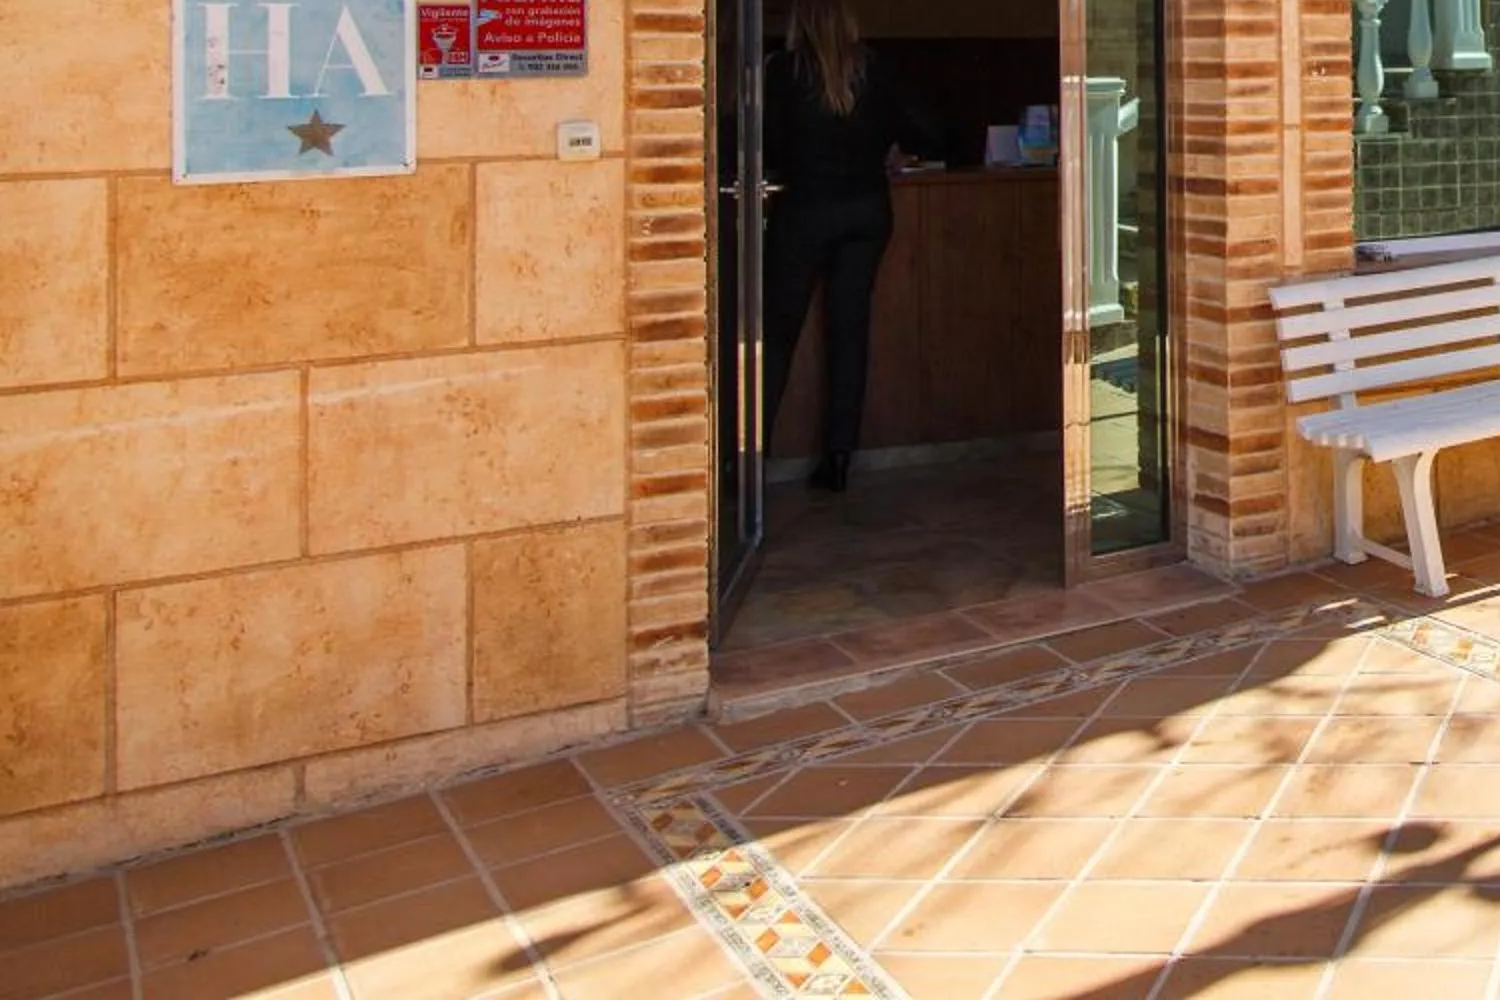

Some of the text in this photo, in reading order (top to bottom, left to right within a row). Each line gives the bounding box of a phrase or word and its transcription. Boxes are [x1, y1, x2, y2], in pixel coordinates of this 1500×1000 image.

[504, 15, 522, 27] de
[483, 31, 522, 44] Aviso
[525, 35, 535, 43] a
[196, 2, 393, 100] HA
